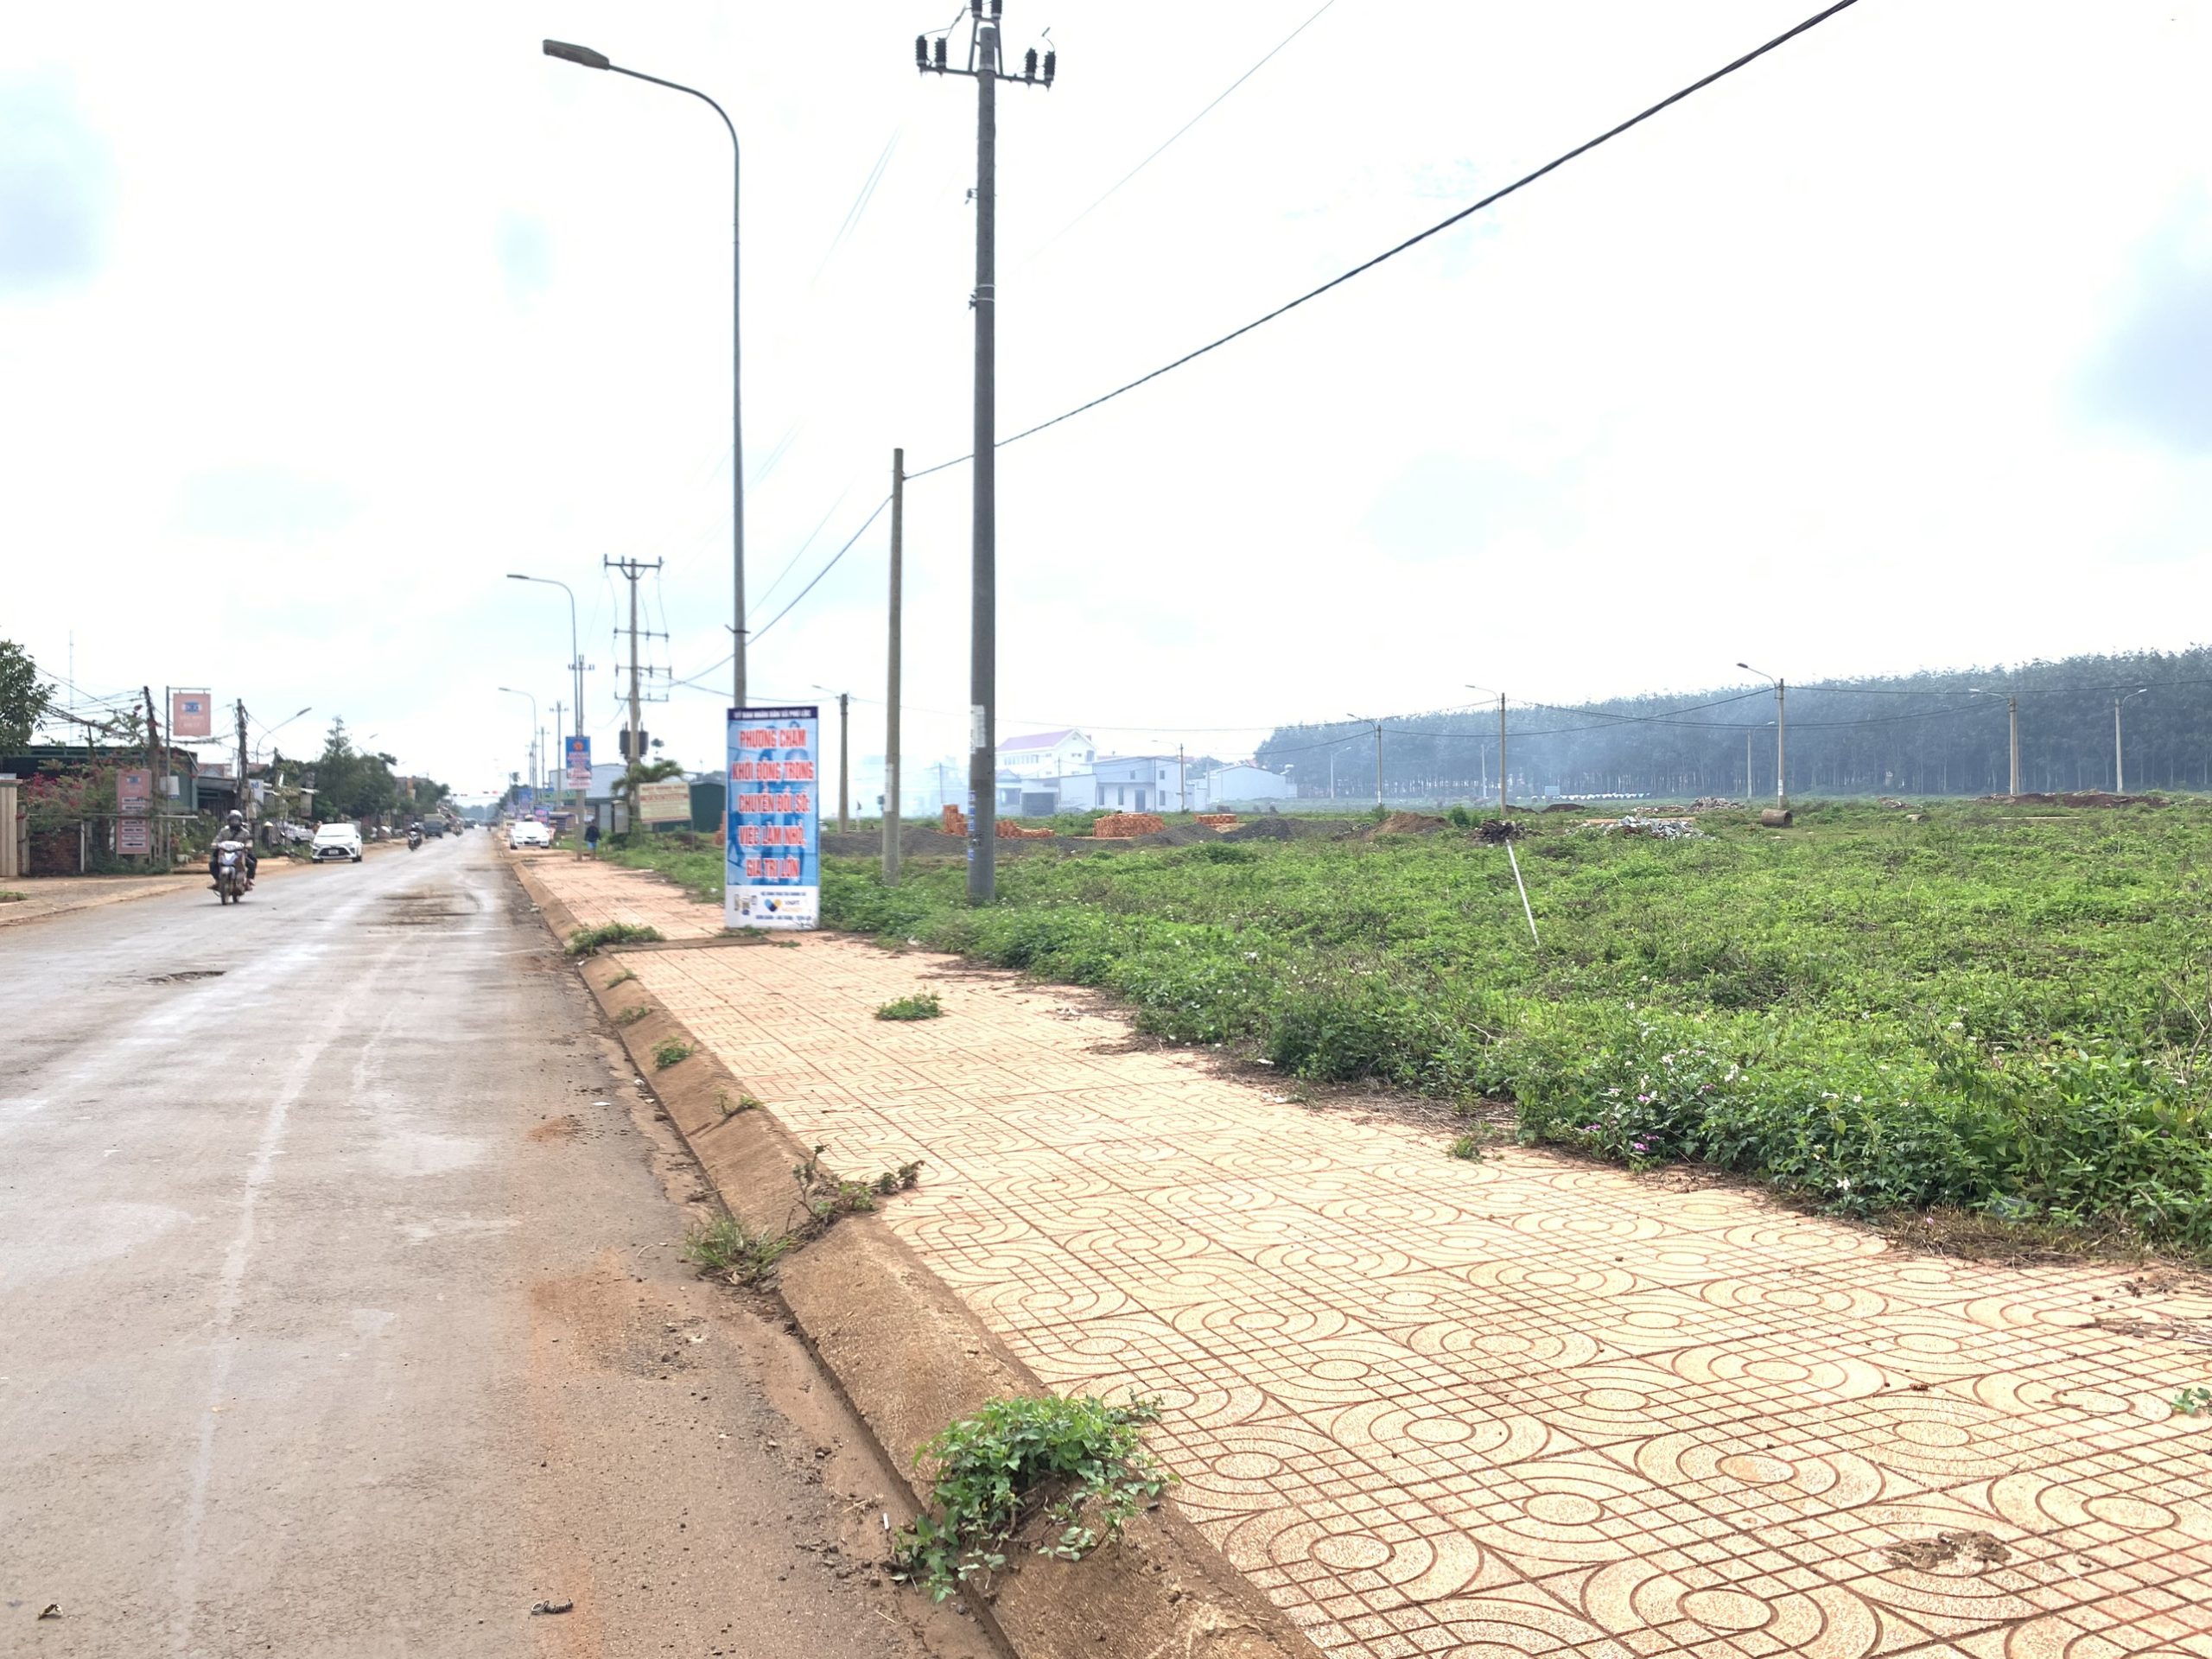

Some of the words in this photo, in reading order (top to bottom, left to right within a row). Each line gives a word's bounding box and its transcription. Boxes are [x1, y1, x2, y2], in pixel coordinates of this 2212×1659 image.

[739, 728, 777, 748] PHƯƠNG
[732, 756, 753, 780] KHỞI
[784, 760, 815, 781] TRONG
[739, 784, 775, 813] CHUYỂN
[761, 821, 782, 845] LÀM
